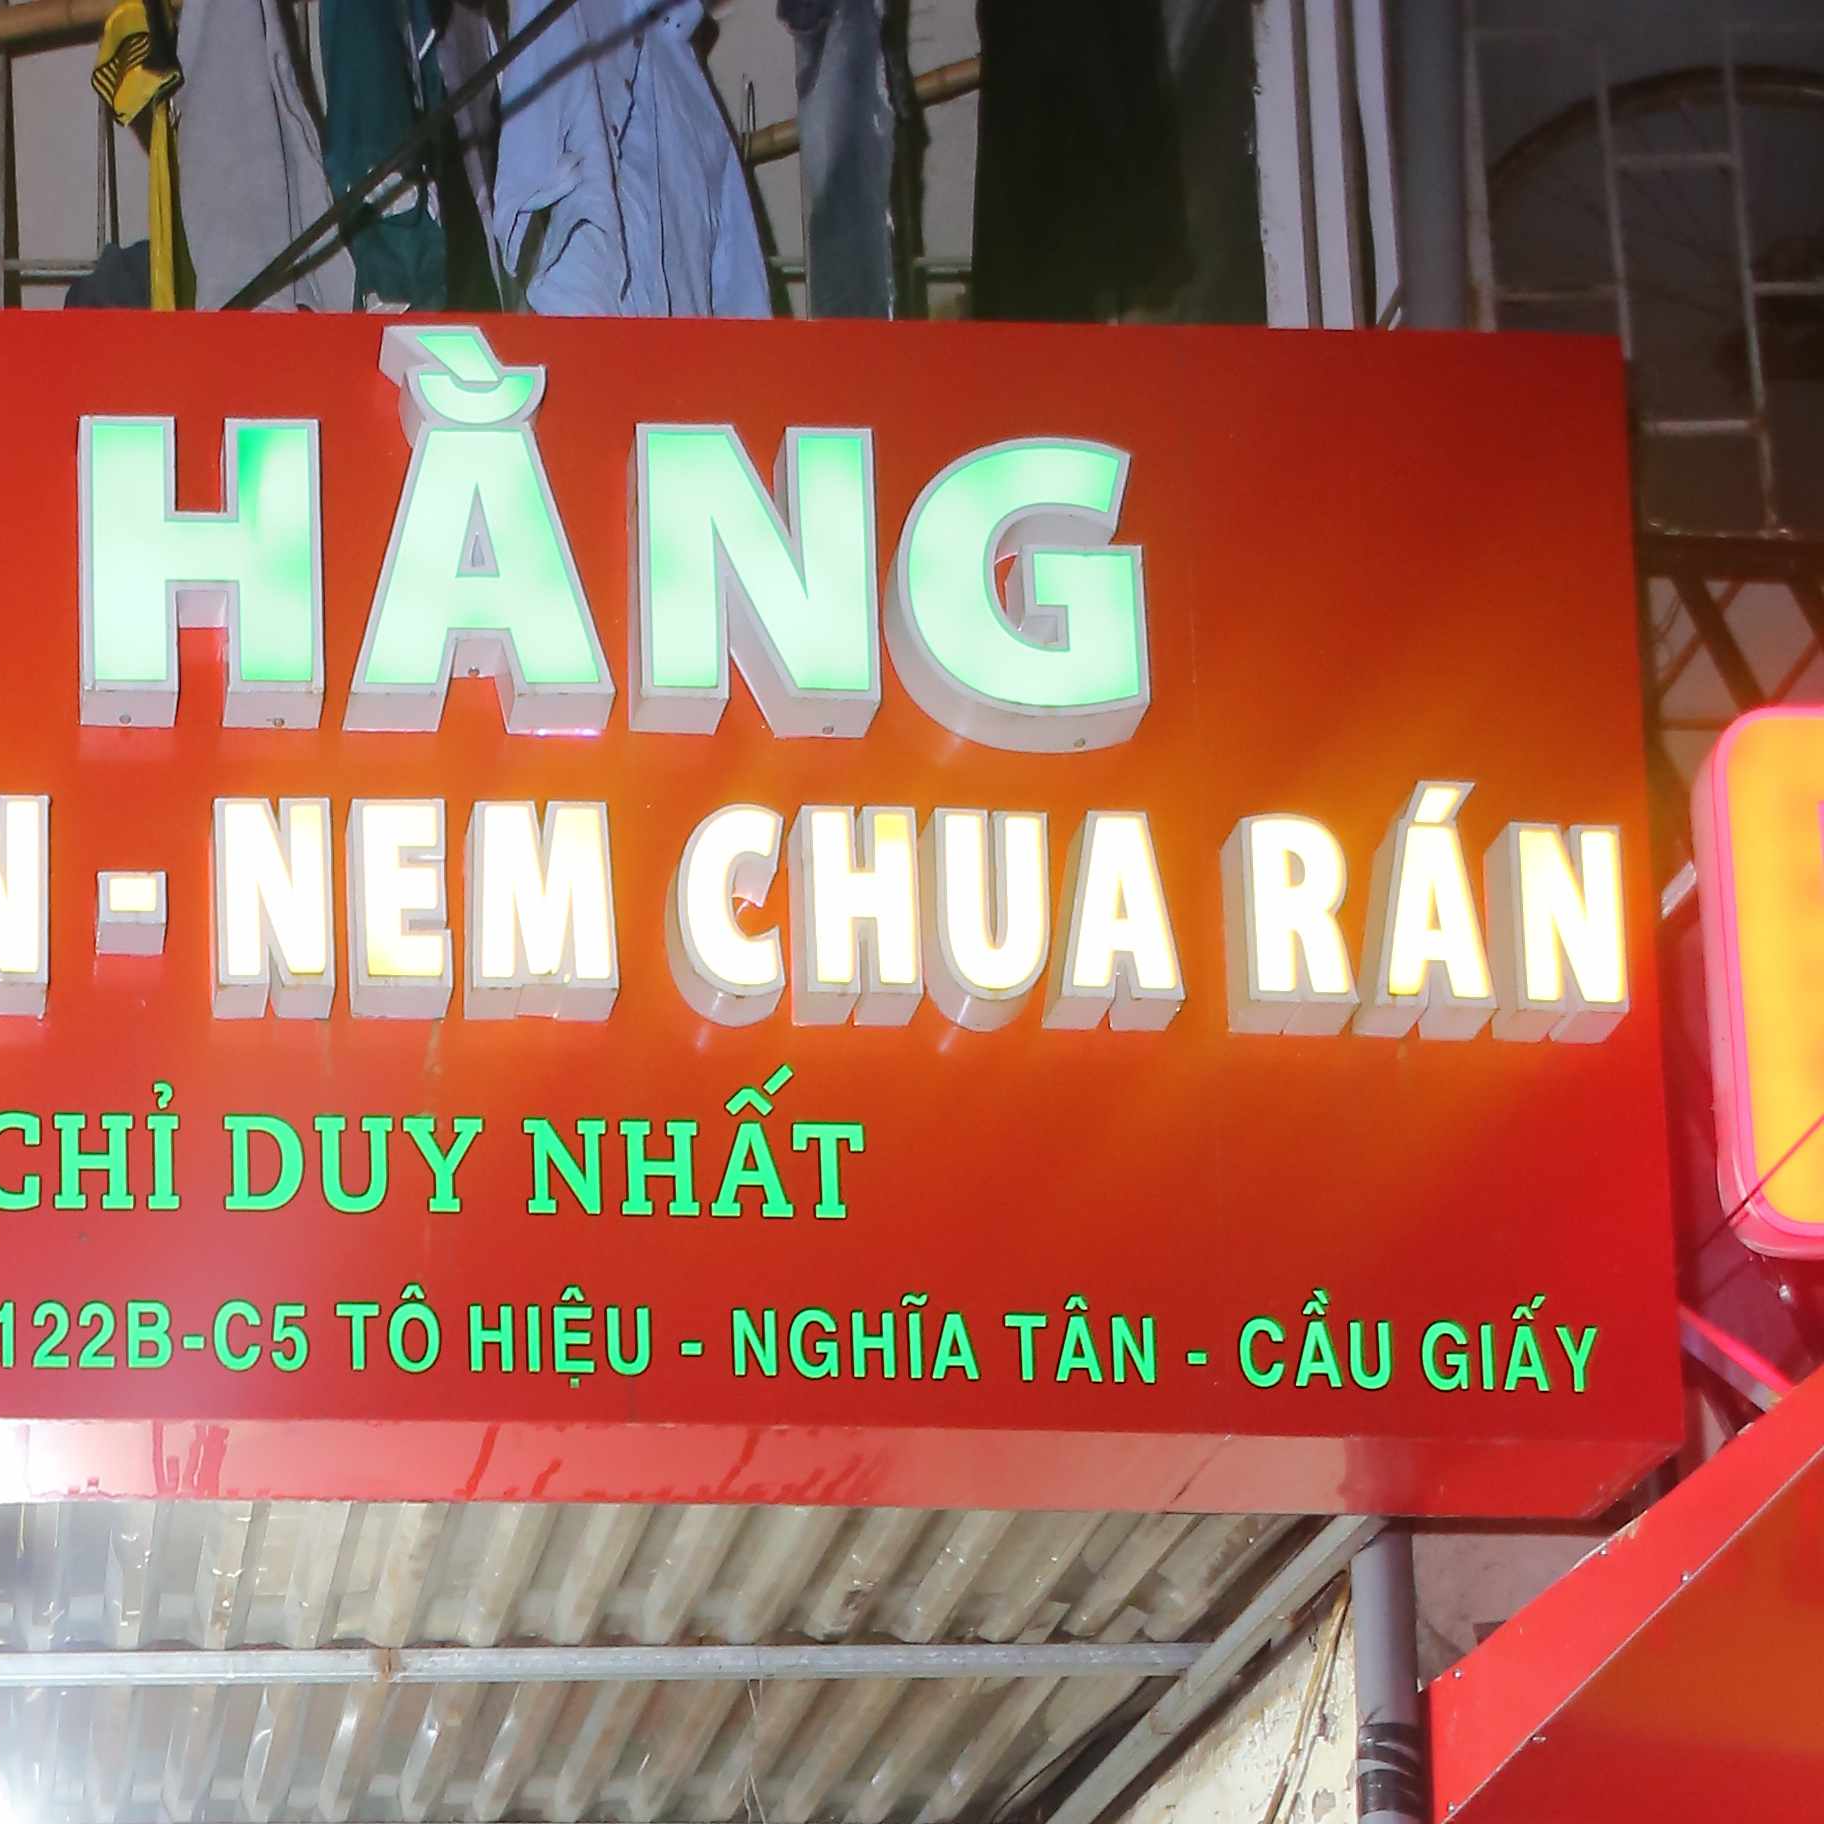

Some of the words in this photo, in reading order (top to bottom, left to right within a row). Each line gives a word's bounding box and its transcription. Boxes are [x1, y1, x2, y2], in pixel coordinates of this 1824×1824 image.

[78, 325, 1149, 753] HẰNG
[95, 870, 167, 955] -
[211, 797, 622, 1021] NEM
[670, 804, 1186, 1032] CHUA
[1221, 780, 1629, 1042] RÁN
[223, 1112, 484, 1213] DUY
[522, 1063, 866, 1220] NHẤT
[335, 1282, 441, 1373] TÔ
[468, 1284, 652, 1387] HIỆU
[680, 1340, 703, 1356] -
[731, 1292, 981, 1381] NGHĨA
[1004, 1294, 1157, 1384] TÂN
[1186, 1350, 1208, 1366] -
[1238, 1288, 1394, 1390] CẦU
[1420, 1294, 1597, 1393] GIẤY
